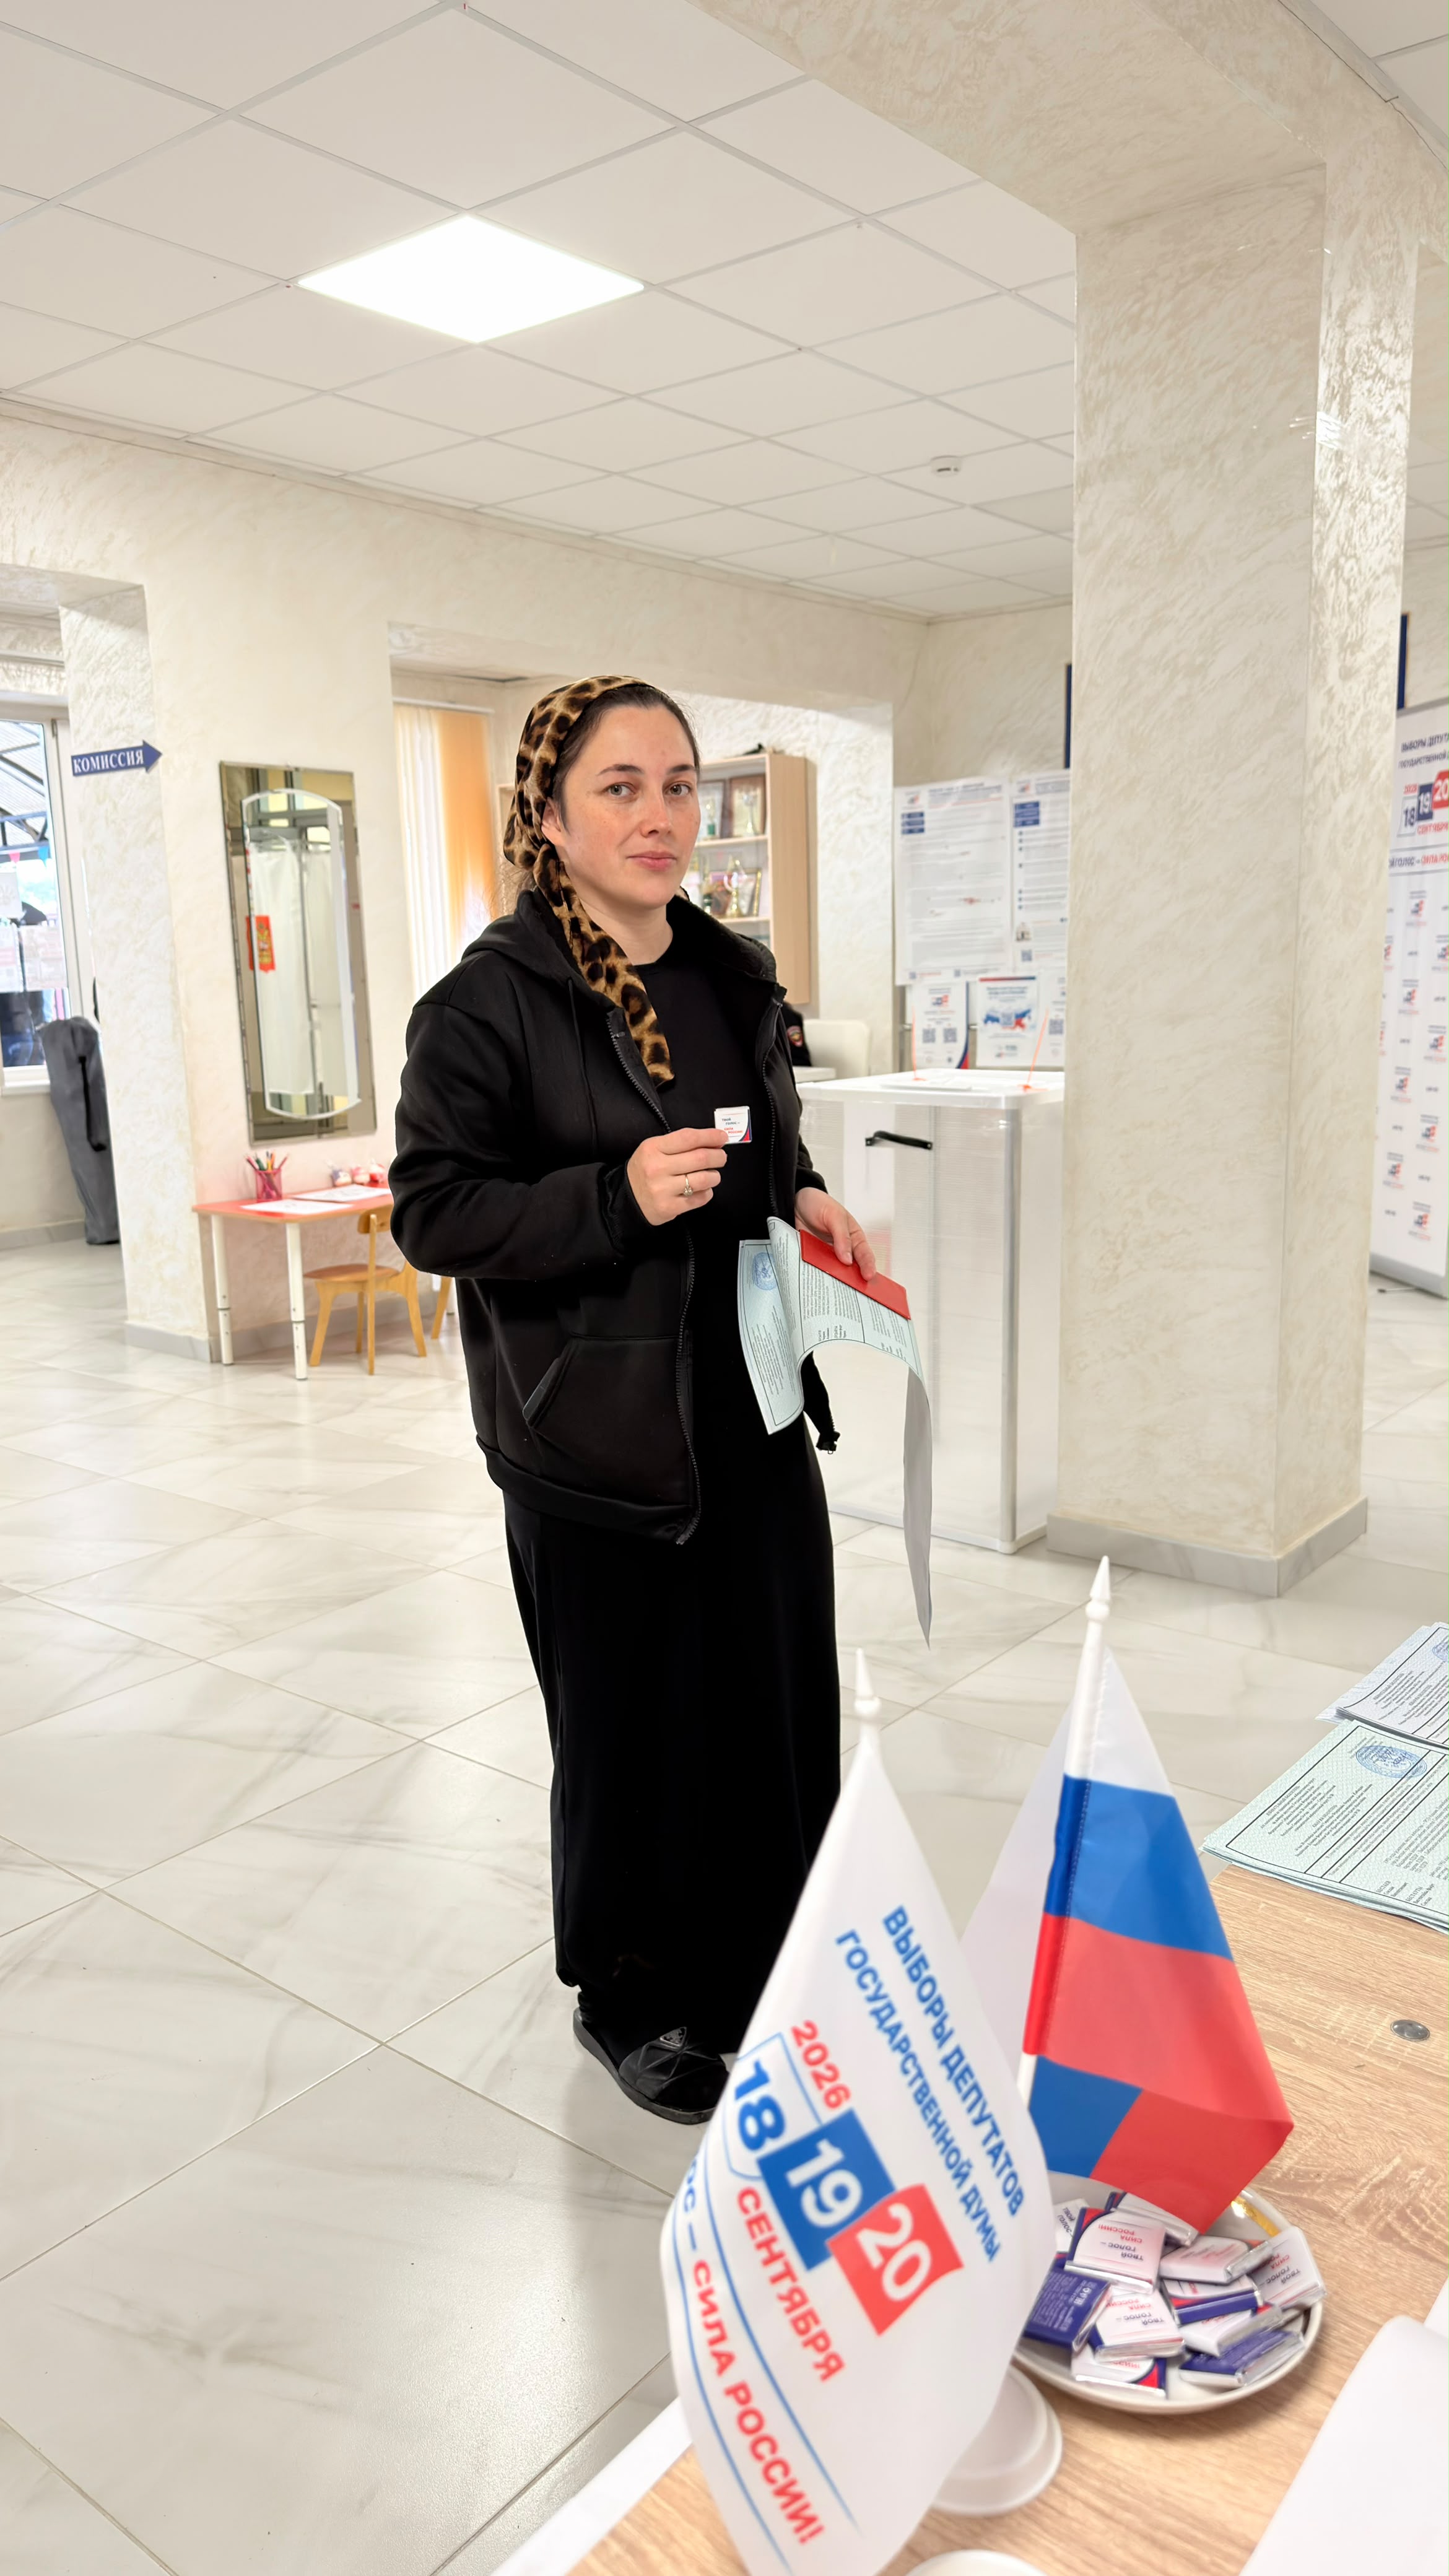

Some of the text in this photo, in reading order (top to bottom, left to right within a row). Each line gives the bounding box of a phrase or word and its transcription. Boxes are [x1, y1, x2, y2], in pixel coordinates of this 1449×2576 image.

[1401, 738, 1426, 752] ВЫБОРЫ
[73, 749, 144, 773] КОМИССИЯ
[1404, 779, 1449, 827] 18 19 20
[790, 2019, 851, 2110] 2026
[882, 1905, 1025, 2217] ВЫБОРЫ ДЕПУТАТОВ
[835, 1929, 1001, 2263] ГОСУДАРСТВЕННОЙ ДУМЫ
[735, 2059, 932, 2302] 18 19 20
[1057, 2214, 1073, 2233] ГОЛОС
[1098, 2224, 1135, 2235] РОССИИ!
[1108, 2242, 1136, 2252] ГОЛОС
[1120, 2235, 1142, 2243] СИЛА
[1120, 2251, 1144, 2261] ТВОЙ
[1271, 2254, 1290, 2269] СИЛА
[1266, 2266, 1290, 2284] ГОЛОС
[1281, 2268, 1301, 2284] ТВОЙ
[737, 2187, 845, 2382] СЕНТЯБРЯ
[1123, 2312, 1152, 2321] ГОЛОС
[1142, 2317, 1165, 2326] ТВОЙ
[692, 2259, 736, 2377] СИЛА
[724, 2380, 825, 2545] РОССИИ!
